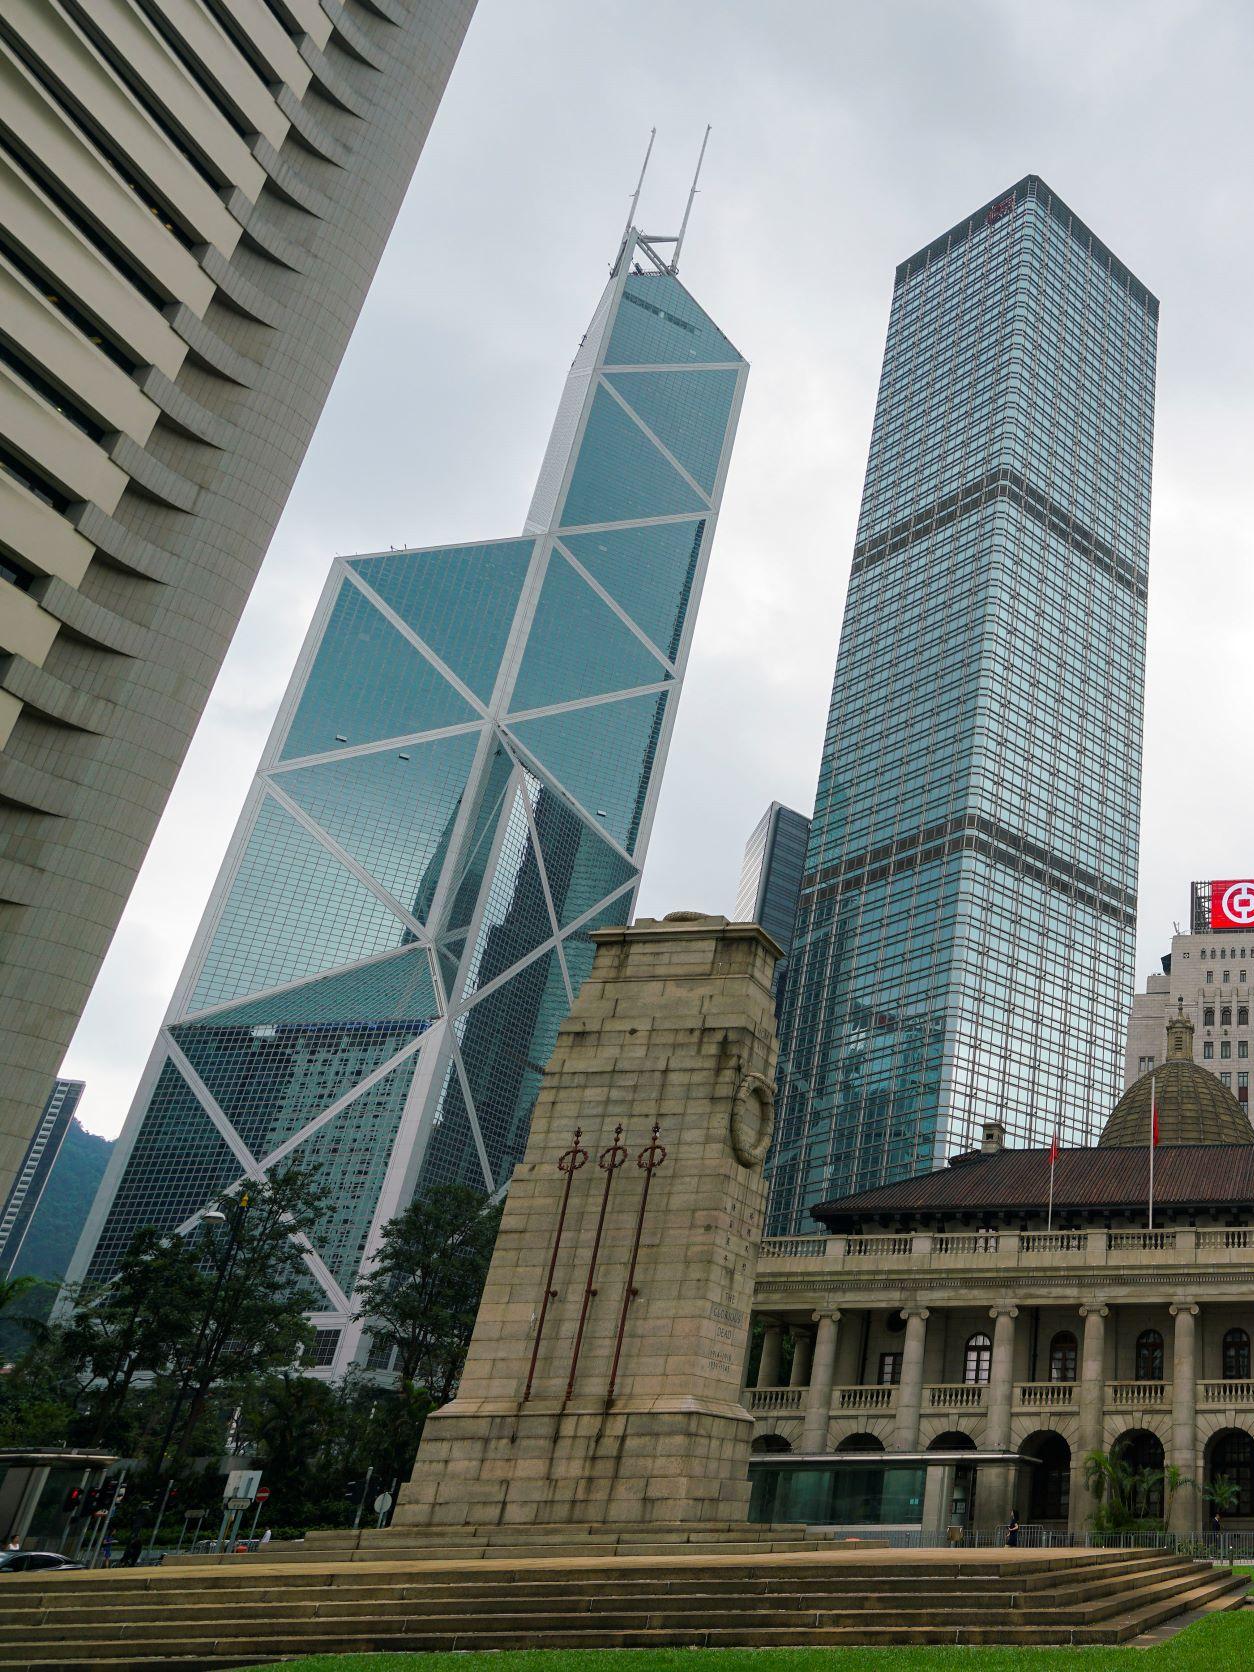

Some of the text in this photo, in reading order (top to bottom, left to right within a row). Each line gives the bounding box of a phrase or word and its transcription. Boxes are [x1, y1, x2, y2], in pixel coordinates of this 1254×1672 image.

[725, 1292, 736, 1304] THE
[713, 1306, 741, 1324] GLORIOUS
[717, 1326, 732, 1340] DEAD
